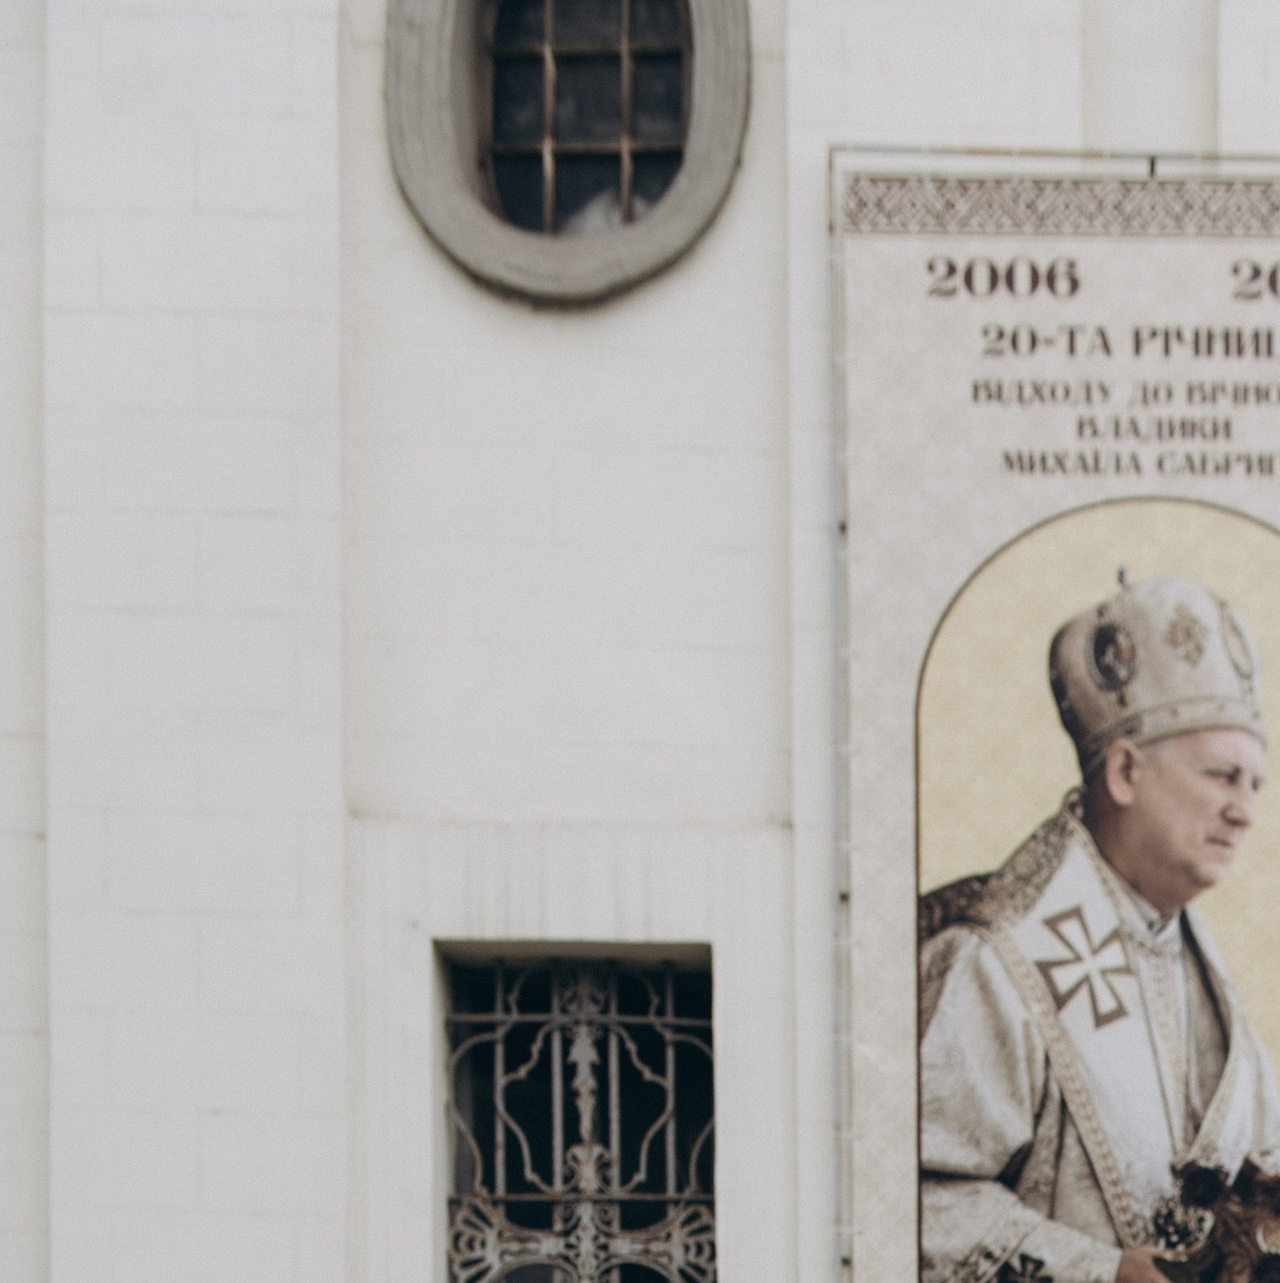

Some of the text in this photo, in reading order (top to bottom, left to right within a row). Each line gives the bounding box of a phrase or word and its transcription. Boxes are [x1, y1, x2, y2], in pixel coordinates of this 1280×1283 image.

[925, 256, 1083, 301] 2006
[980, 324, 1114, 360] 20-ТА
[1128, 380, 1175, 410] ДО
